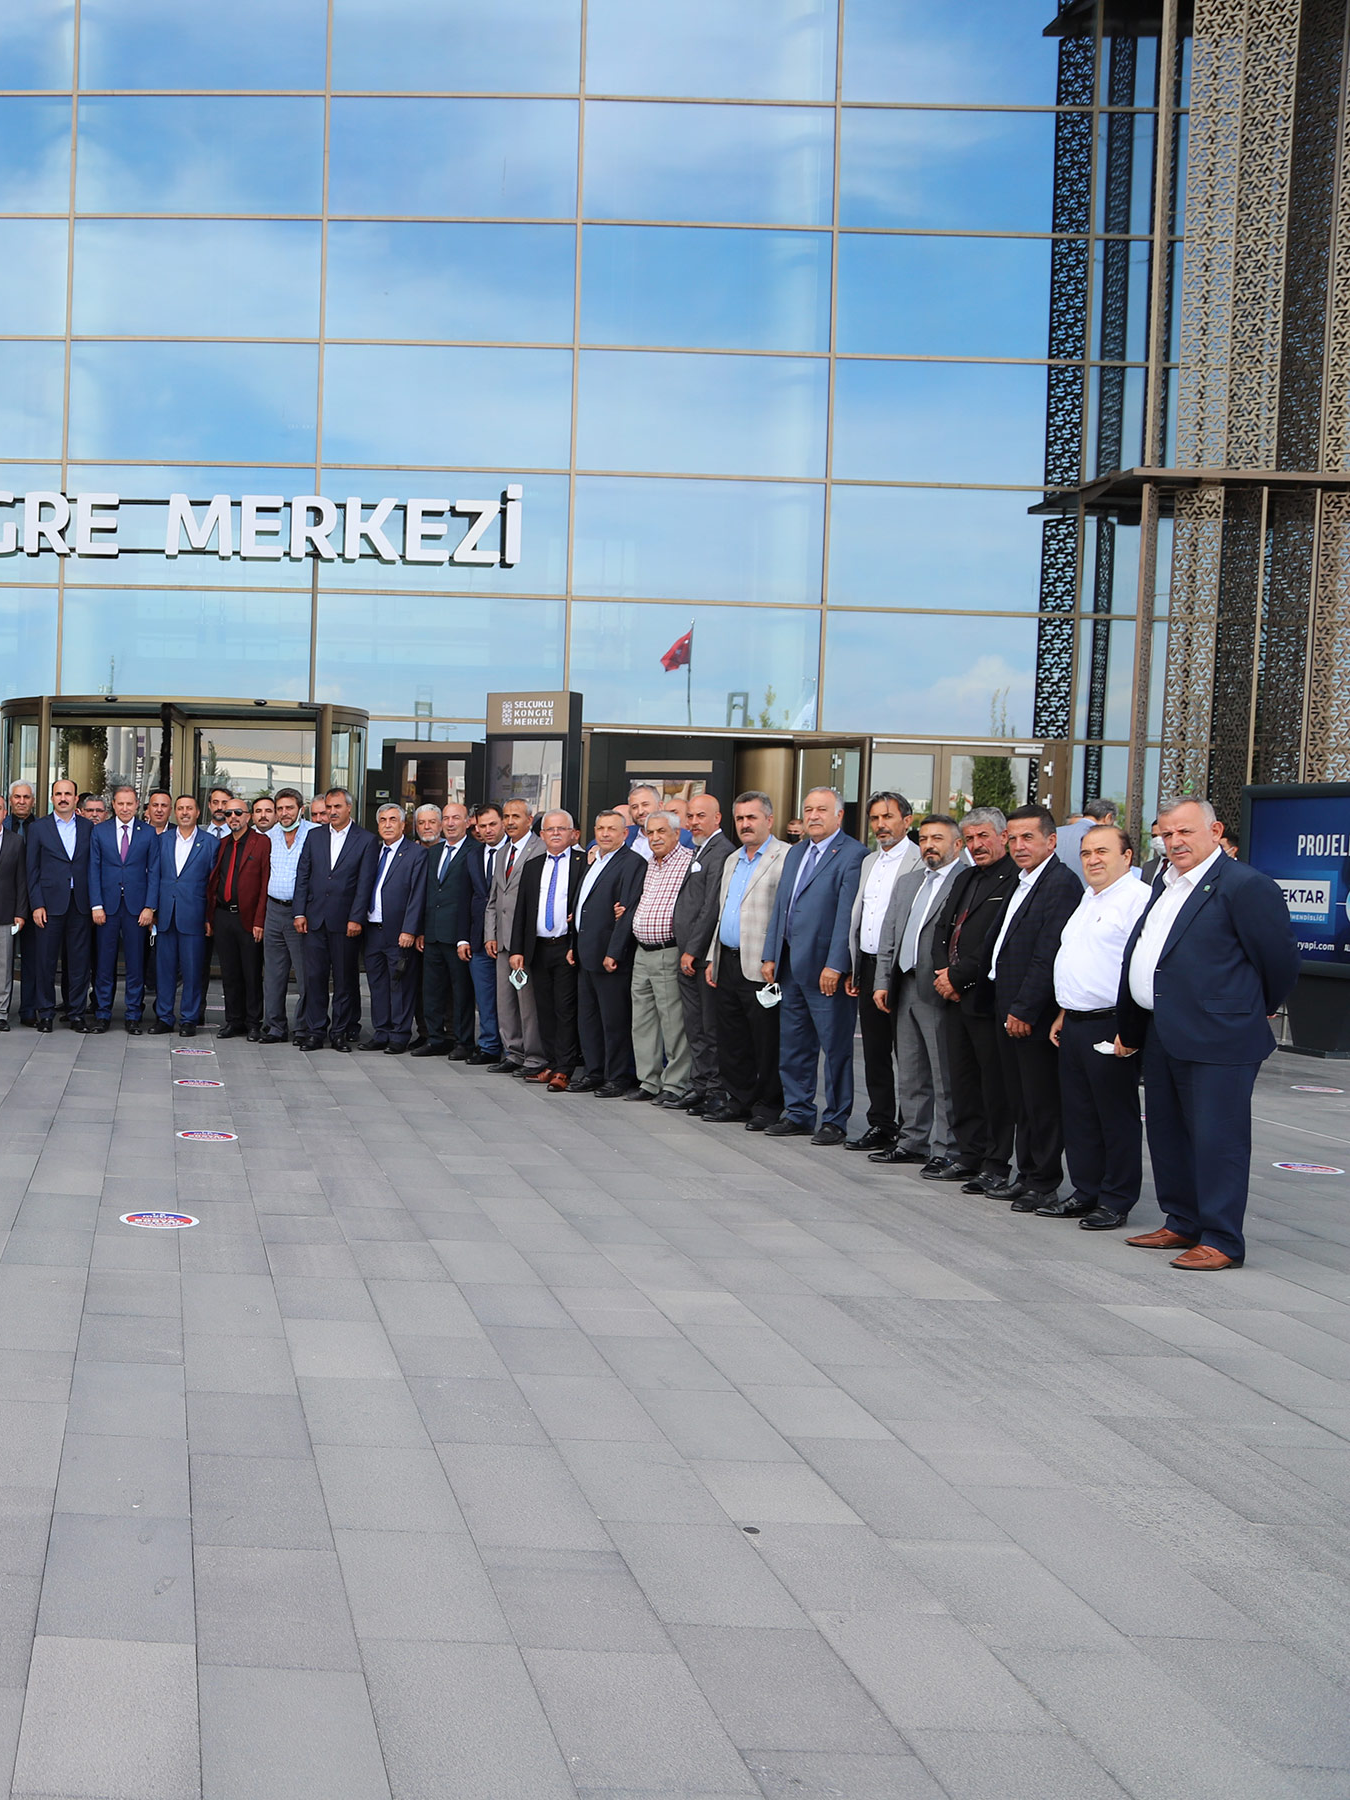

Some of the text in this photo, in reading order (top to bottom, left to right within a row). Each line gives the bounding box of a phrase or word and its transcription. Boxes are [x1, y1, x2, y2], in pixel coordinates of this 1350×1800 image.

[166, 484, 524, 565] MERKEZİ
[513, 700, 554, 709] SELÇUKLU
[513, 709, 554, 717] KONGRE
[513, 717, 554, 726] MERKEZİ
[1297, 834, 1350, 857] PROJEL
[1281, 889, 1324, 904] EKTAR
[1297, 941, 1335, 951] ryapi.com
